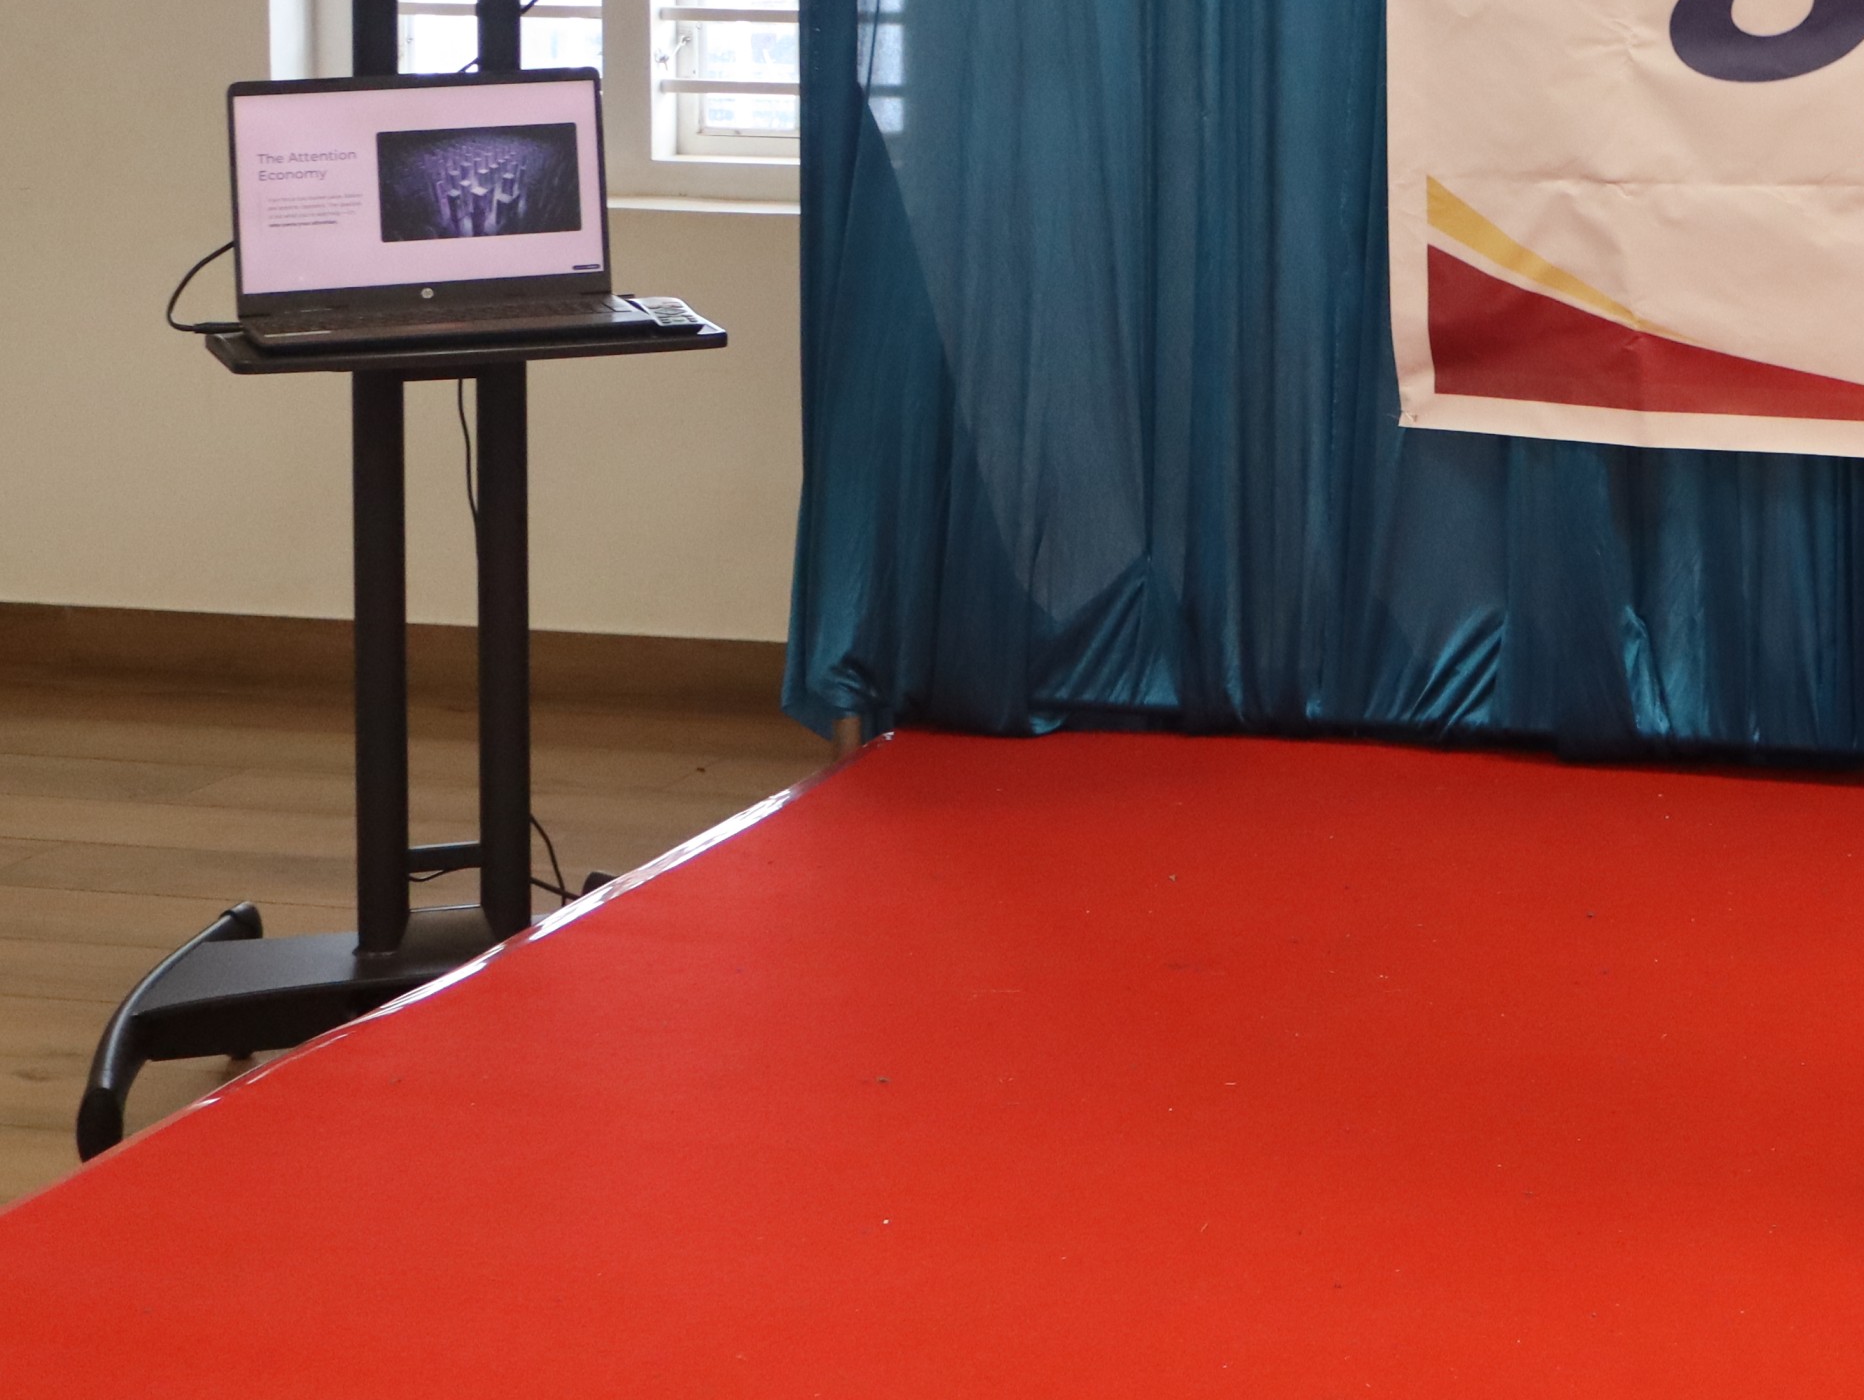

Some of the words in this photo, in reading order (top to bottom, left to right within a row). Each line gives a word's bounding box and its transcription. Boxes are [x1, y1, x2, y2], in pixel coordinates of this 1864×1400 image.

[256, 153, 285, 164] The
[288, 149, 358, 163] Attention
[258, 169, 328, 181] Economy
